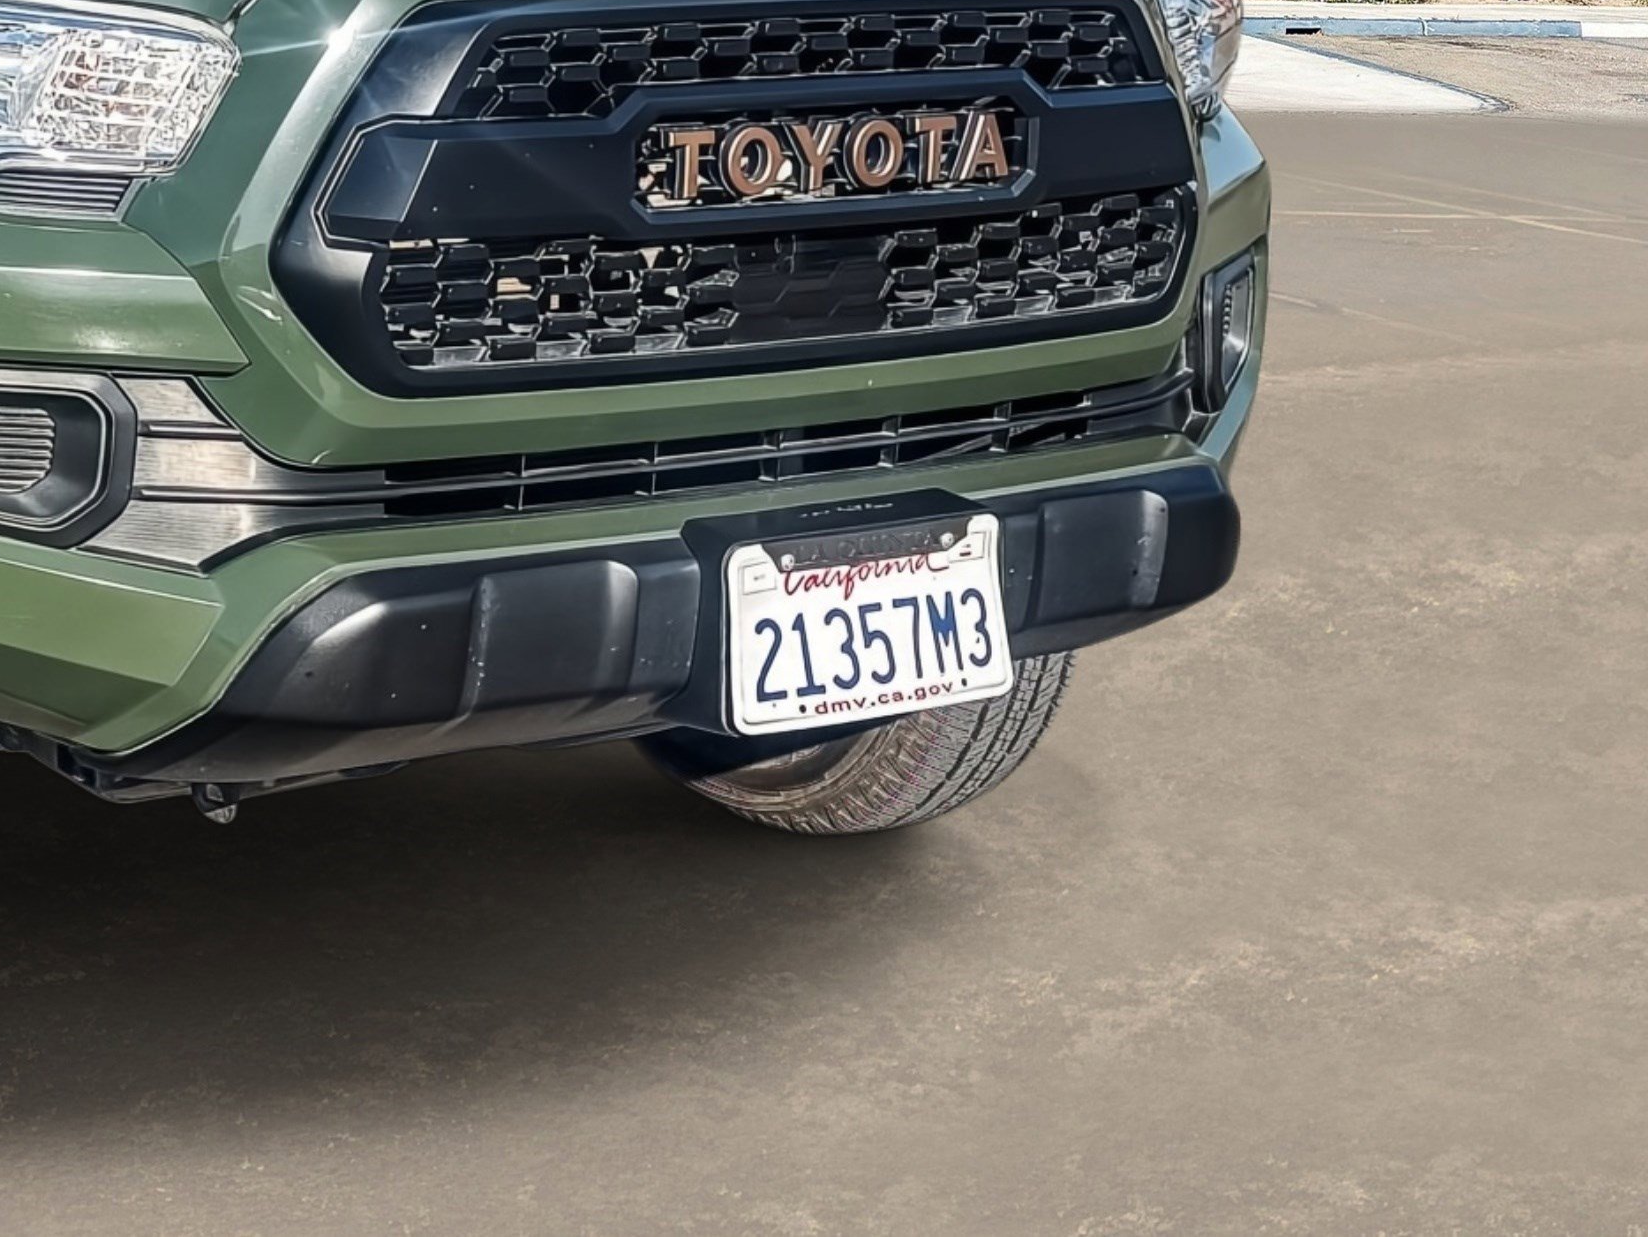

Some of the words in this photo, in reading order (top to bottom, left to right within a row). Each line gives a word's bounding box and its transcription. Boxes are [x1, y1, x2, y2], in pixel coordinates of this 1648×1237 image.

[665, 112, 1009, 201] TOYOTA
[782, 553, 949, 601] California
[754, 587, 993, 703] 21357M3
[814, 679, 954, 716] dmv.ca.gov
